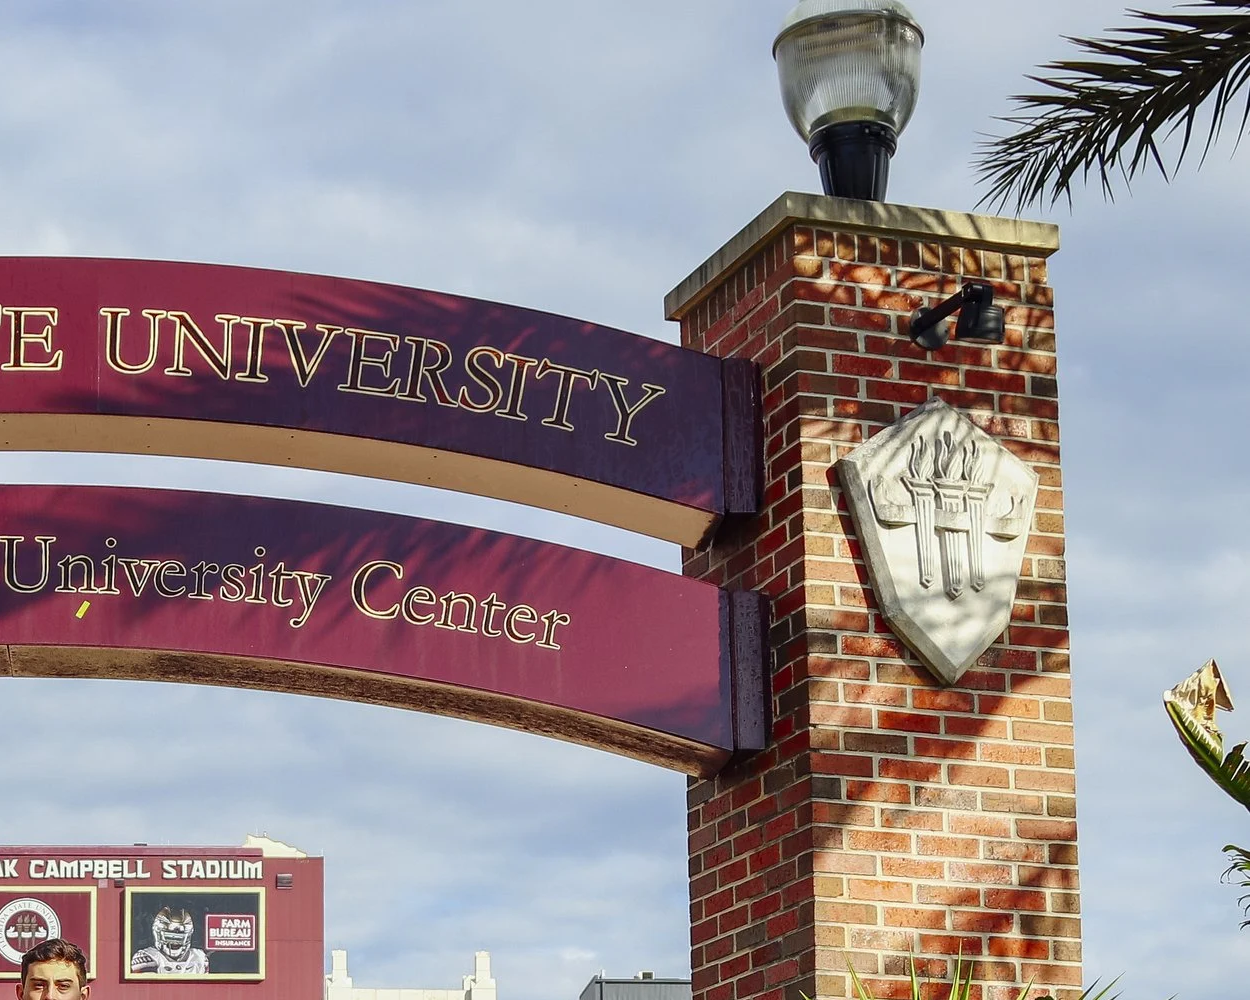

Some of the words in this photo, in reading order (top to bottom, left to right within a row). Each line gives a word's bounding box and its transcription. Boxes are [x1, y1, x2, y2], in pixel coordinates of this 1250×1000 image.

[100, 307, 666, 446] UNIVERSITY
[350, 560, 571, 651] Center
[29, 859, 150, 879] CAMPBELL
[162, 860, 263, 879] STADIUM
[210, 928, 251, 938] BUREAU
[221, 919, 251, 928] FARM
